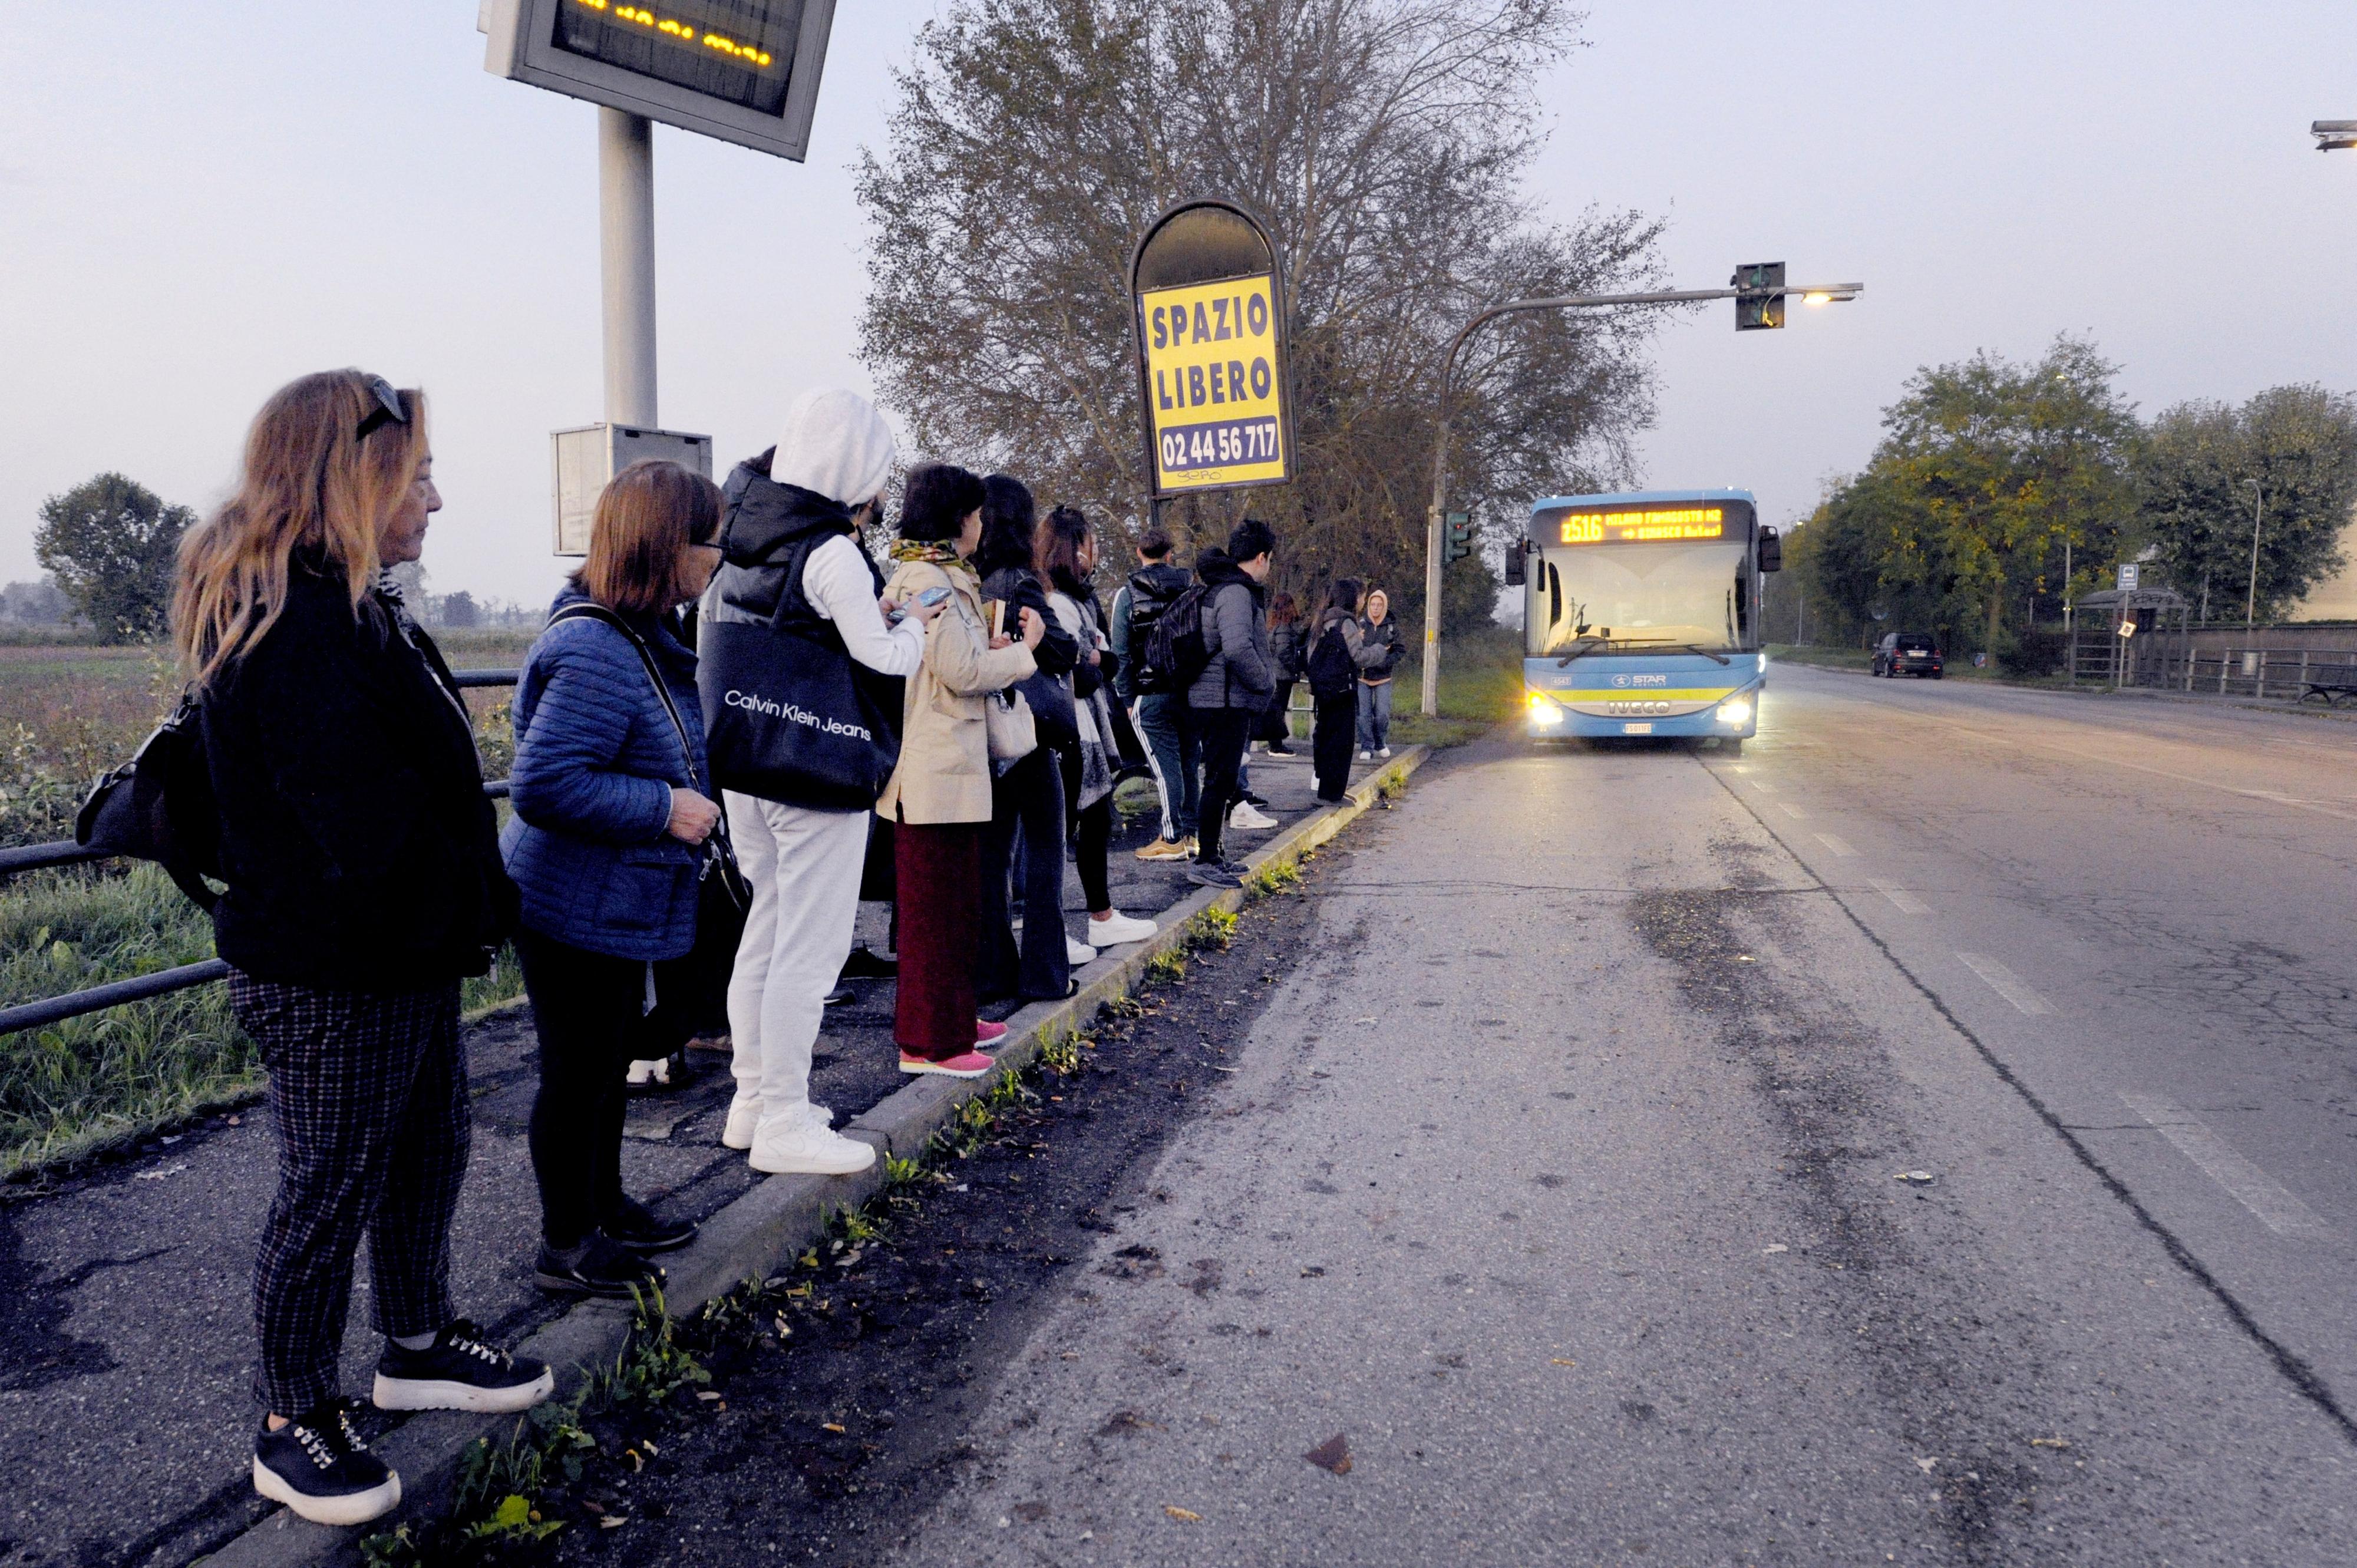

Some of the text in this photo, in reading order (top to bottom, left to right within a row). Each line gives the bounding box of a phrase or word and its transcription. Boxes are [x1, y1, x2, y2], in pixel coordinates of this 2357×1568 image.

[1152, 292, 1267, 349] SPAZIO
[1157, 356, 1272, 410] LIBERO
[1163, 423, 1276, 467] 02 44 56 717
[1562, 514, 1602, 542] z516
[1606, 513, 1643, 526] MILANO
[1645, 510, 1704, 524] FAMAGOSTA
[725, 690, 871, 741] Calvin Klein Jeans
[1609, 701, 1669, 714] IVECO
